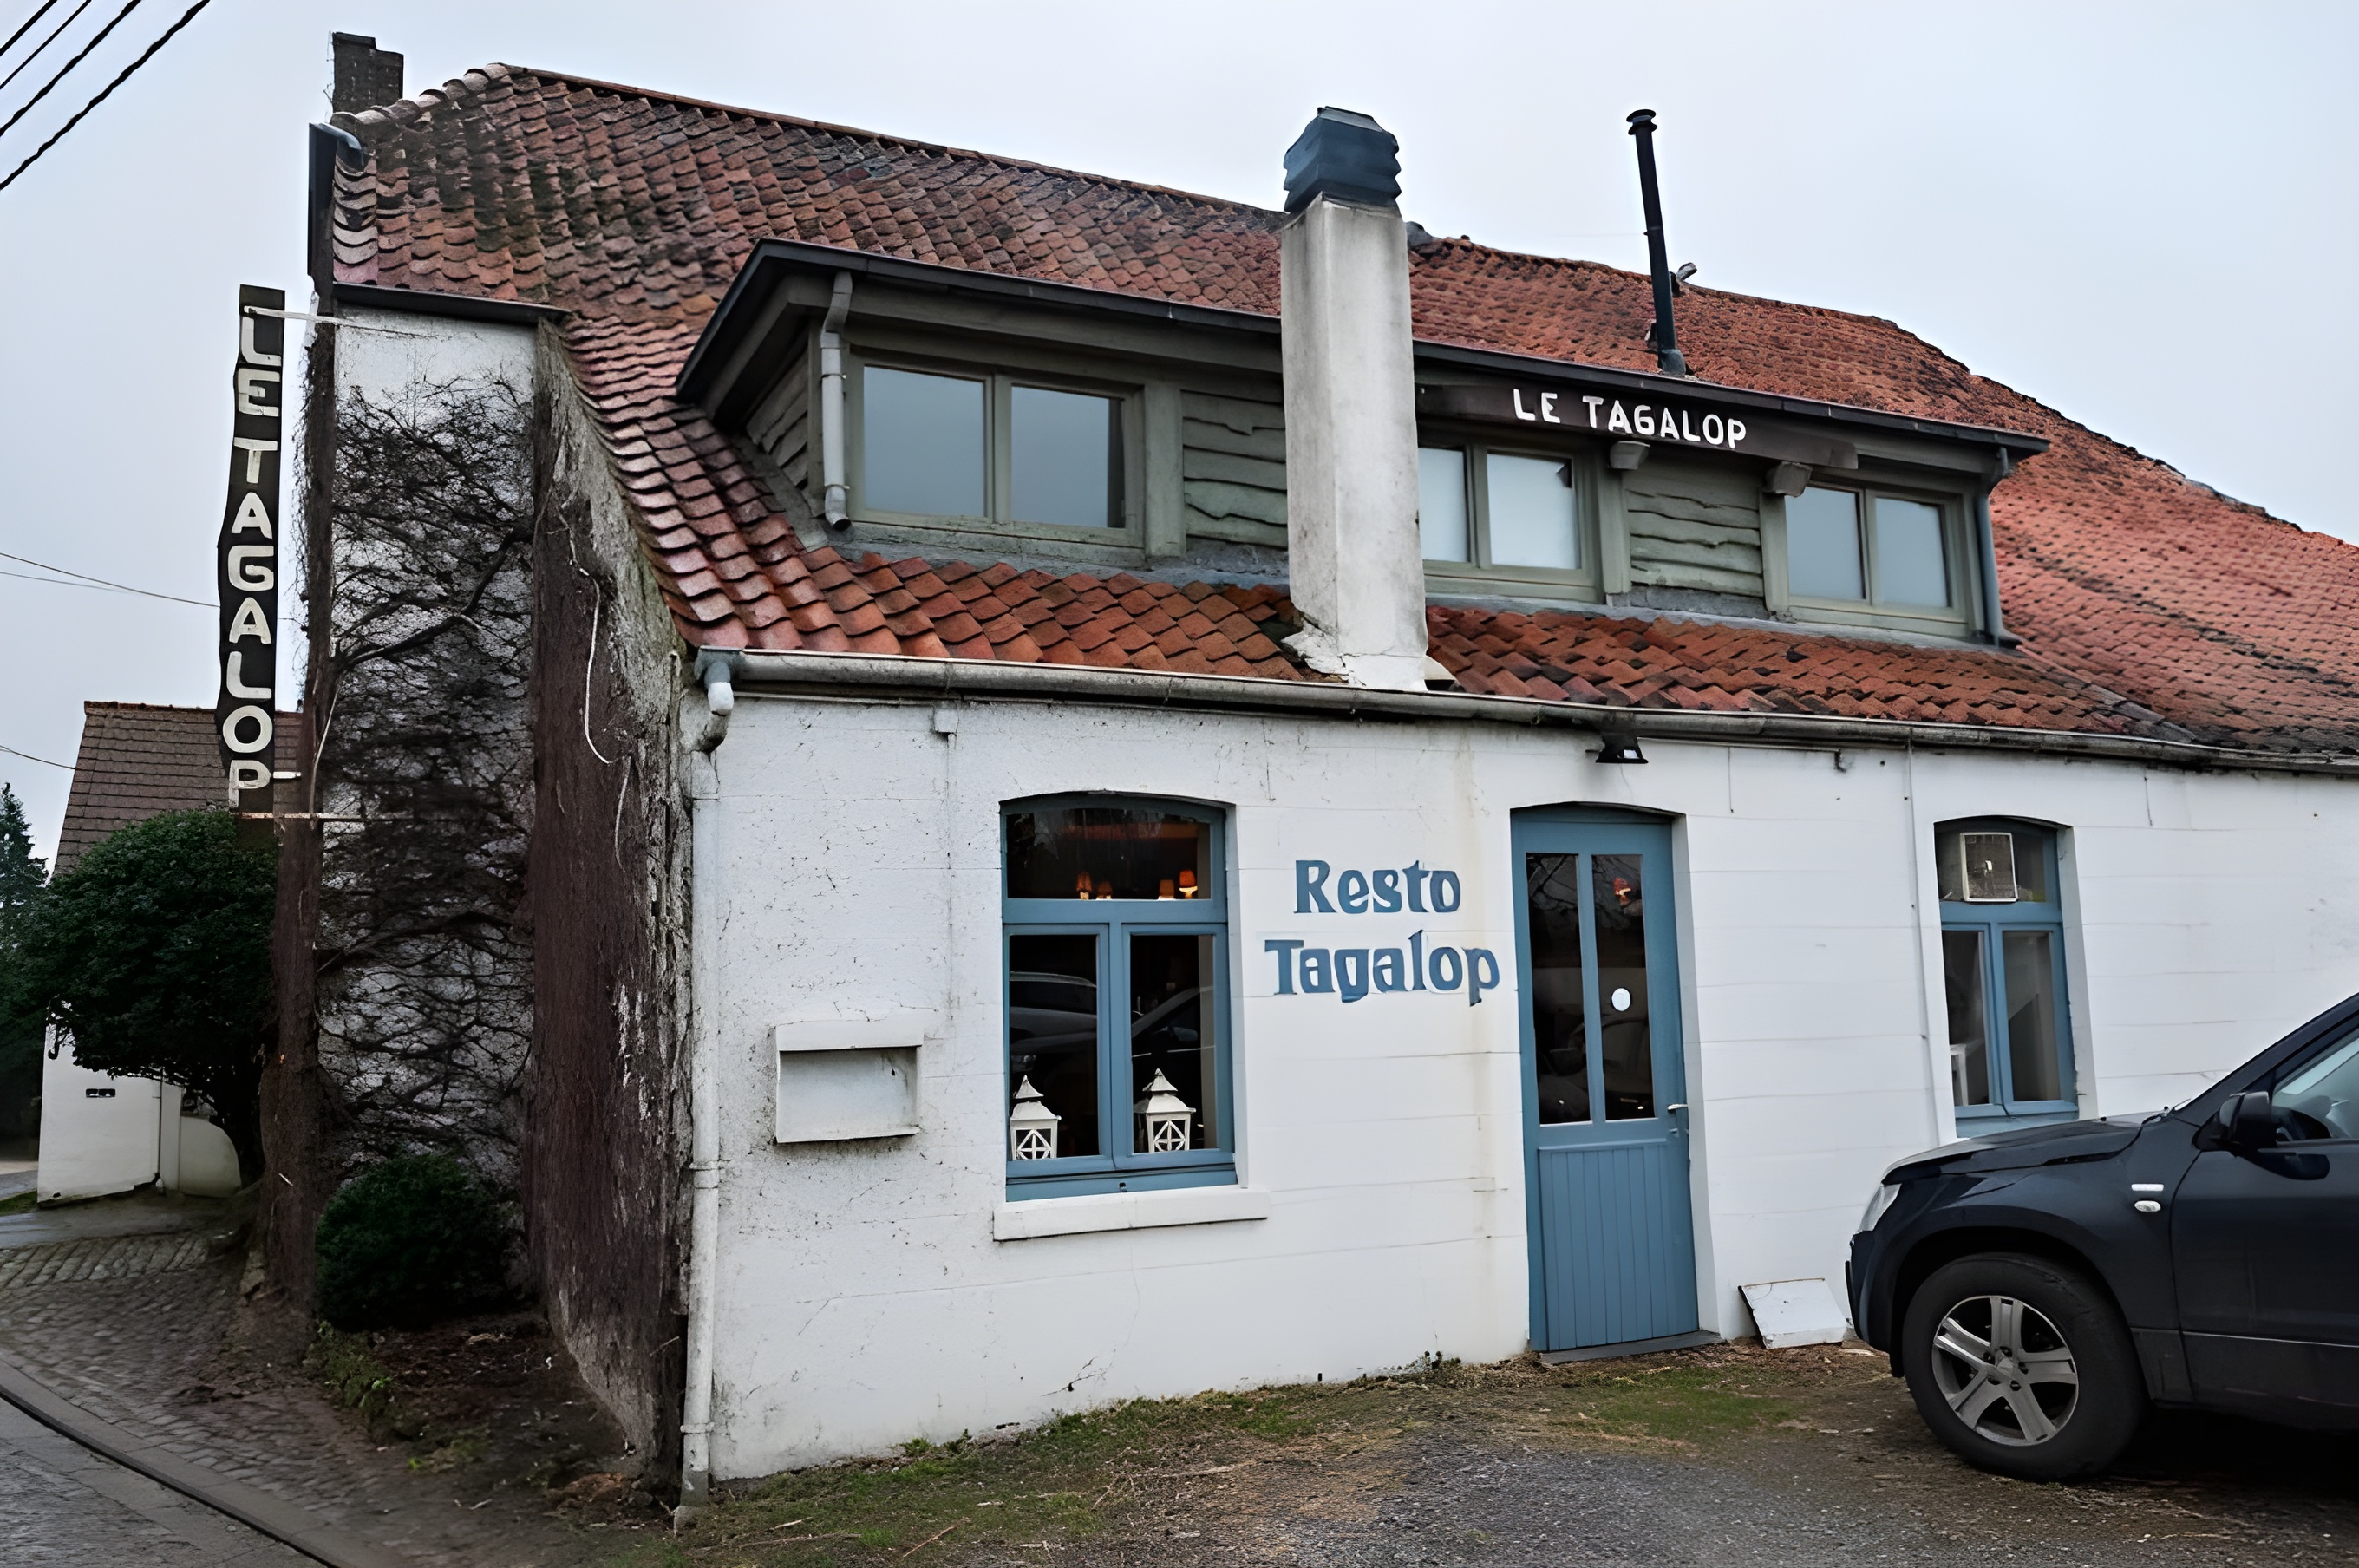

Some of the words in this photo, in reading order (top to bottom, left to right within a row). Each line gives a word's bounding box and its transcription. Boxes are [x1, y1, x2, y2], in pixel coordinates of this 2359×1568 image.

[238, 305, 283, 418] LE
[1513, 388, 1561, 424] LE
[1582, 395, 1747, 449] TAGALOP
[222, 437, 278, 808] TAGALOP
[1293, 859, 1461, 914] Resto
[1264, 929, 1500, 1007] Tagalop
